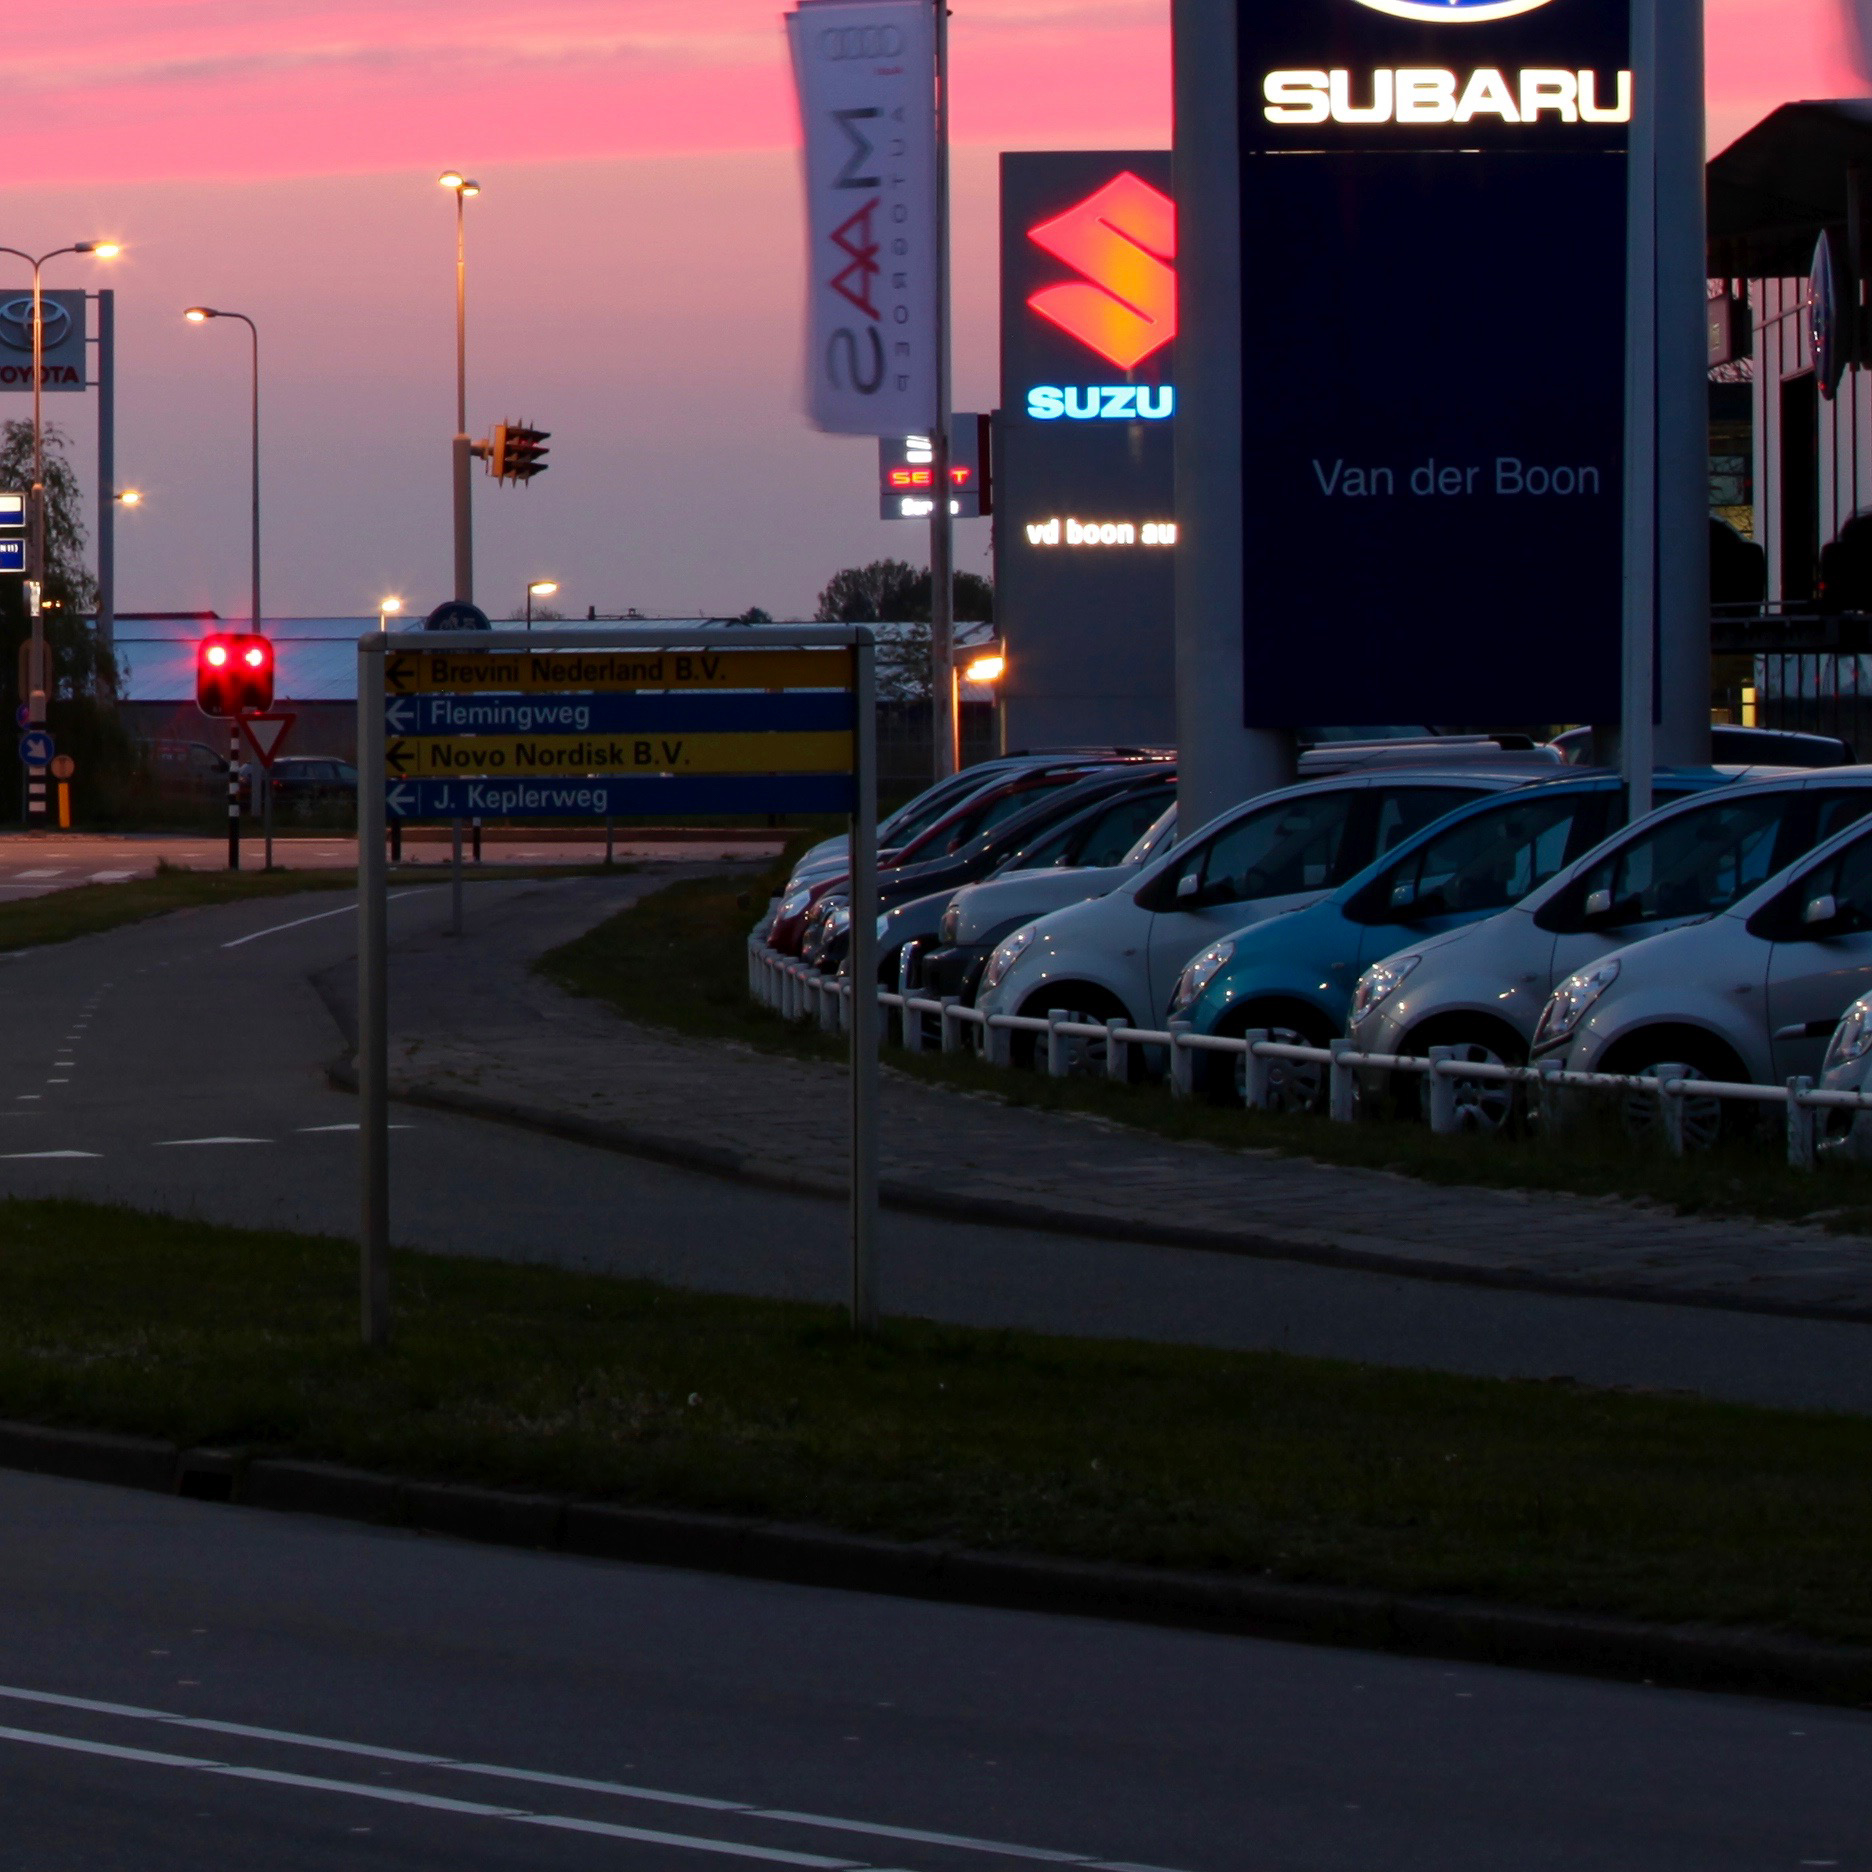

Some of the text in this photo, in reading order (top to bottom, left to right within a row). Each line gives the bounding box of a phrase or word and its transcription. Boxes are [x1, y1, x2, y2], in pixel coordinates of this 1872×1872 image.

[1262, 68, 1632, 124] SUBARU
[1027, 385, 1174, 420] SUZU
[891, 469, 970, 486] SET
[1312, 457, 1600, 497] Van der Boon
[1026, 518, 1177, 545] vd boon au
[431, 656, 726, 683] Brevini Nederland B.V.
[431, 700, 590, 730] Flemingweg
[431, 741, 691, 768] Novo Nordisk B.V.
[433, 784, 608, 814] J. Keplerweg
